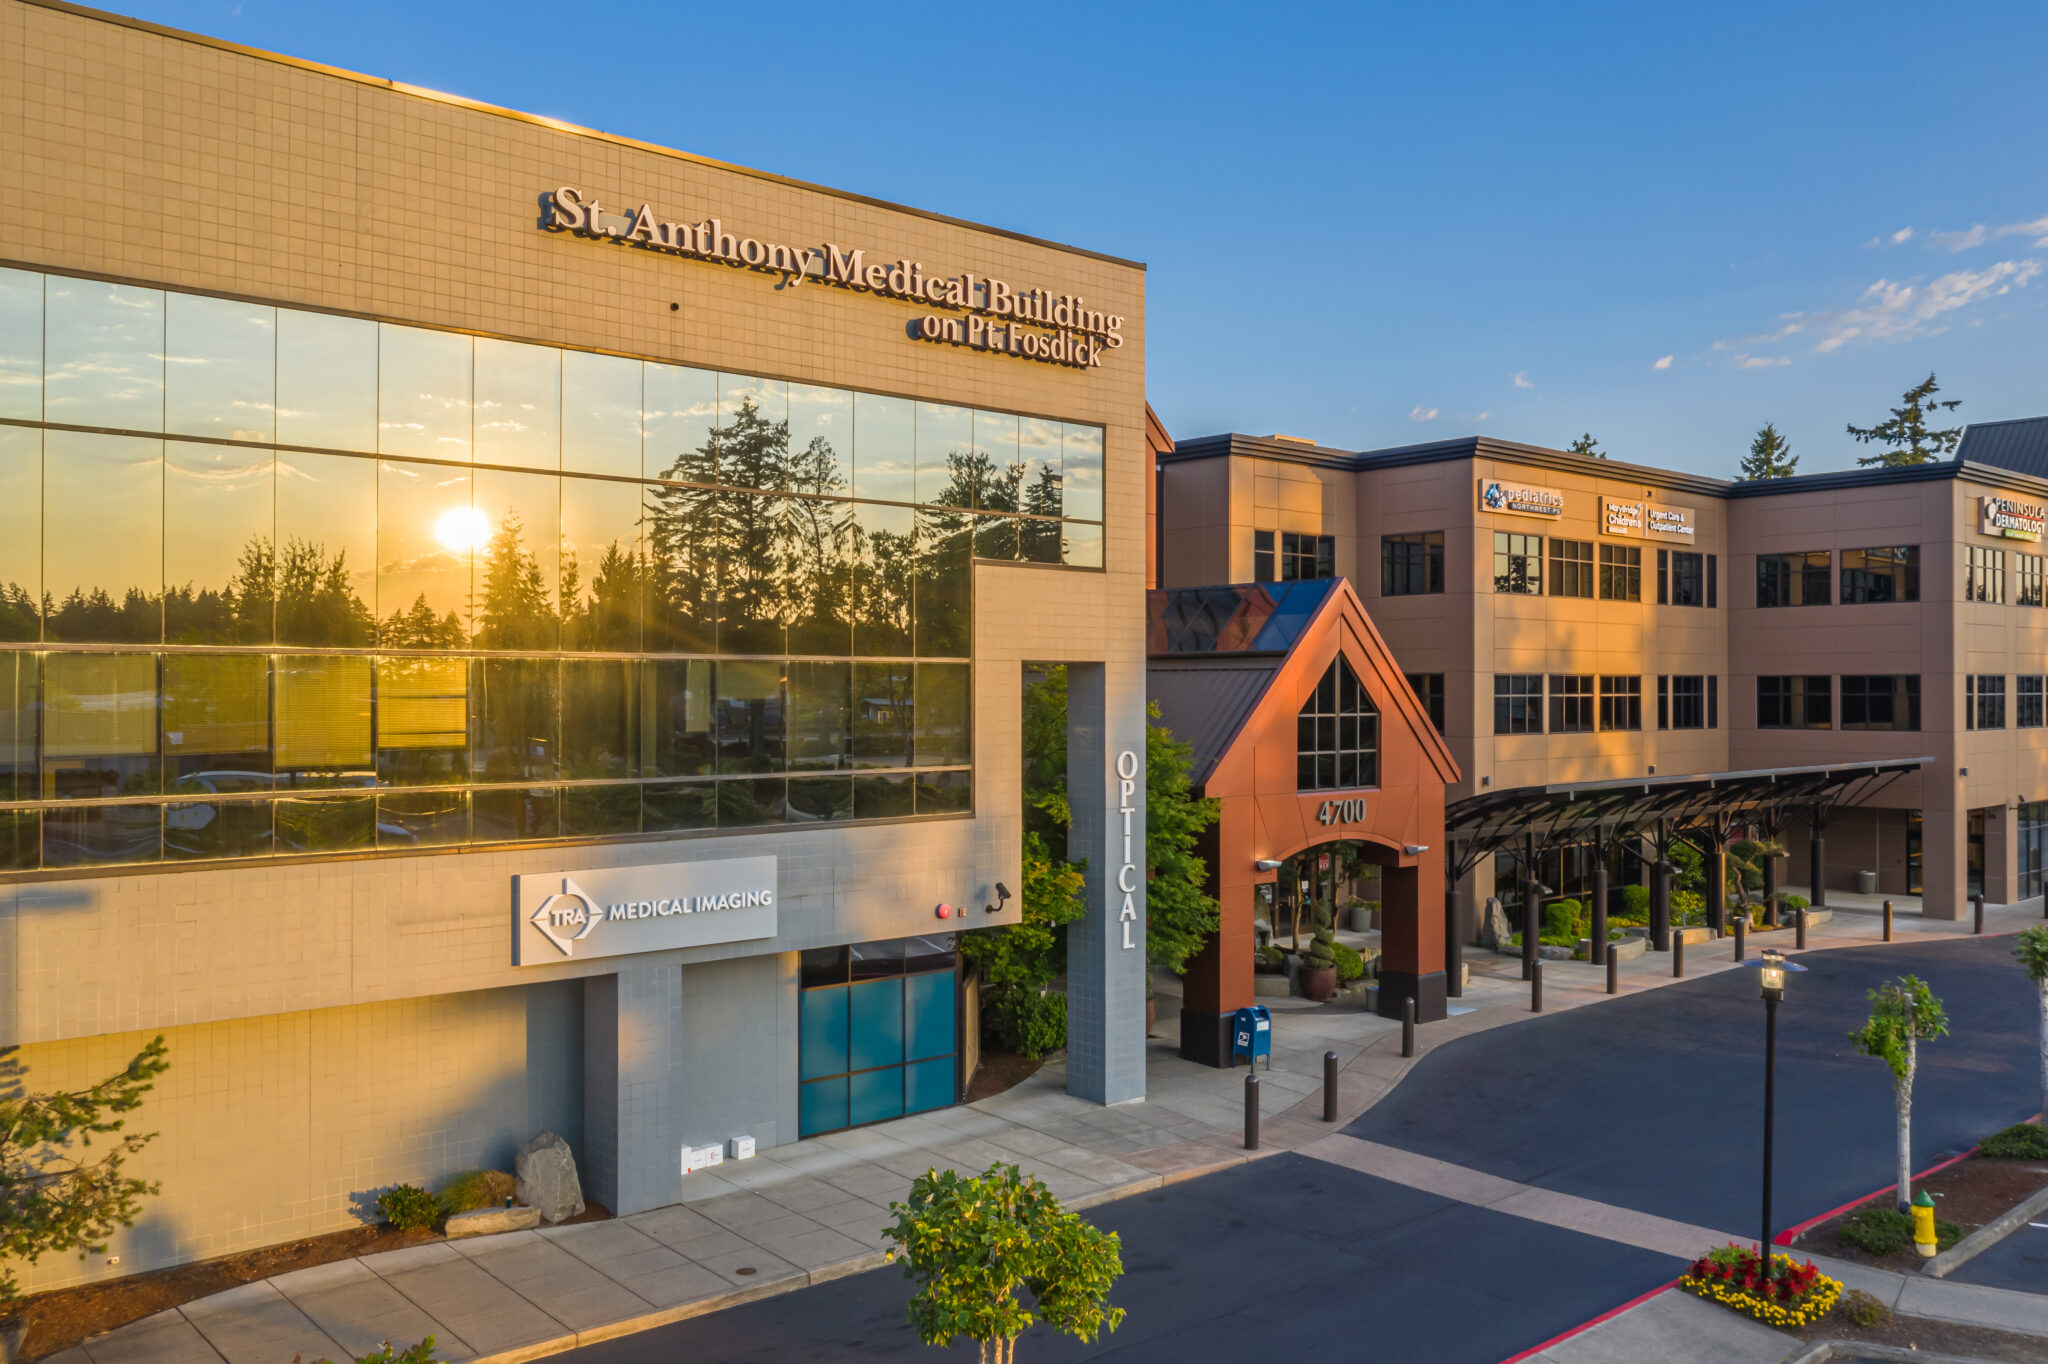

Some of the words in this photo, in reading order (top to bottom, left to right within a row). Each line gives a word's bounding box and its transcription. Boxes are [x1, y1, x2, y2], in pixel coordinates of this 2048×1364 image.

[551, 186, 616, 236] St.
[627, 203, 814, 286] Anthony
[824, 243, 976, 308] Medical
[984, 278, 1125, 349] Building
[922, 311, 961, 342] on
[964, 314, 1003, 350] Pt.
[1006, 324, 1102, 367] Fosdick
[1508, 489, 1565, 507] pediatrics
[1996, 498, 2046, 518] PENINSULA
[1512, 502, 1551, 513] NORTHWEST
[1552, 507, 1561, 515] PS
[1650, 509, 1668, 520] Urgent
[1668, 511, 1680, 521] Care
[1650, 520, 1677, 532] Outpatient
[1677, 524, 1694, 535] Center
[1996, 514, 2046, 534] DERMATOLOGY
[1319, 799, 1367, 826] 4700
[1117, 751, 1138, 951] OPTICAL
[551, 908, 588, 928] TRA
[608, 899, 693, 921] MEDICAL
[696, 889, 773, 913] IMAGING
